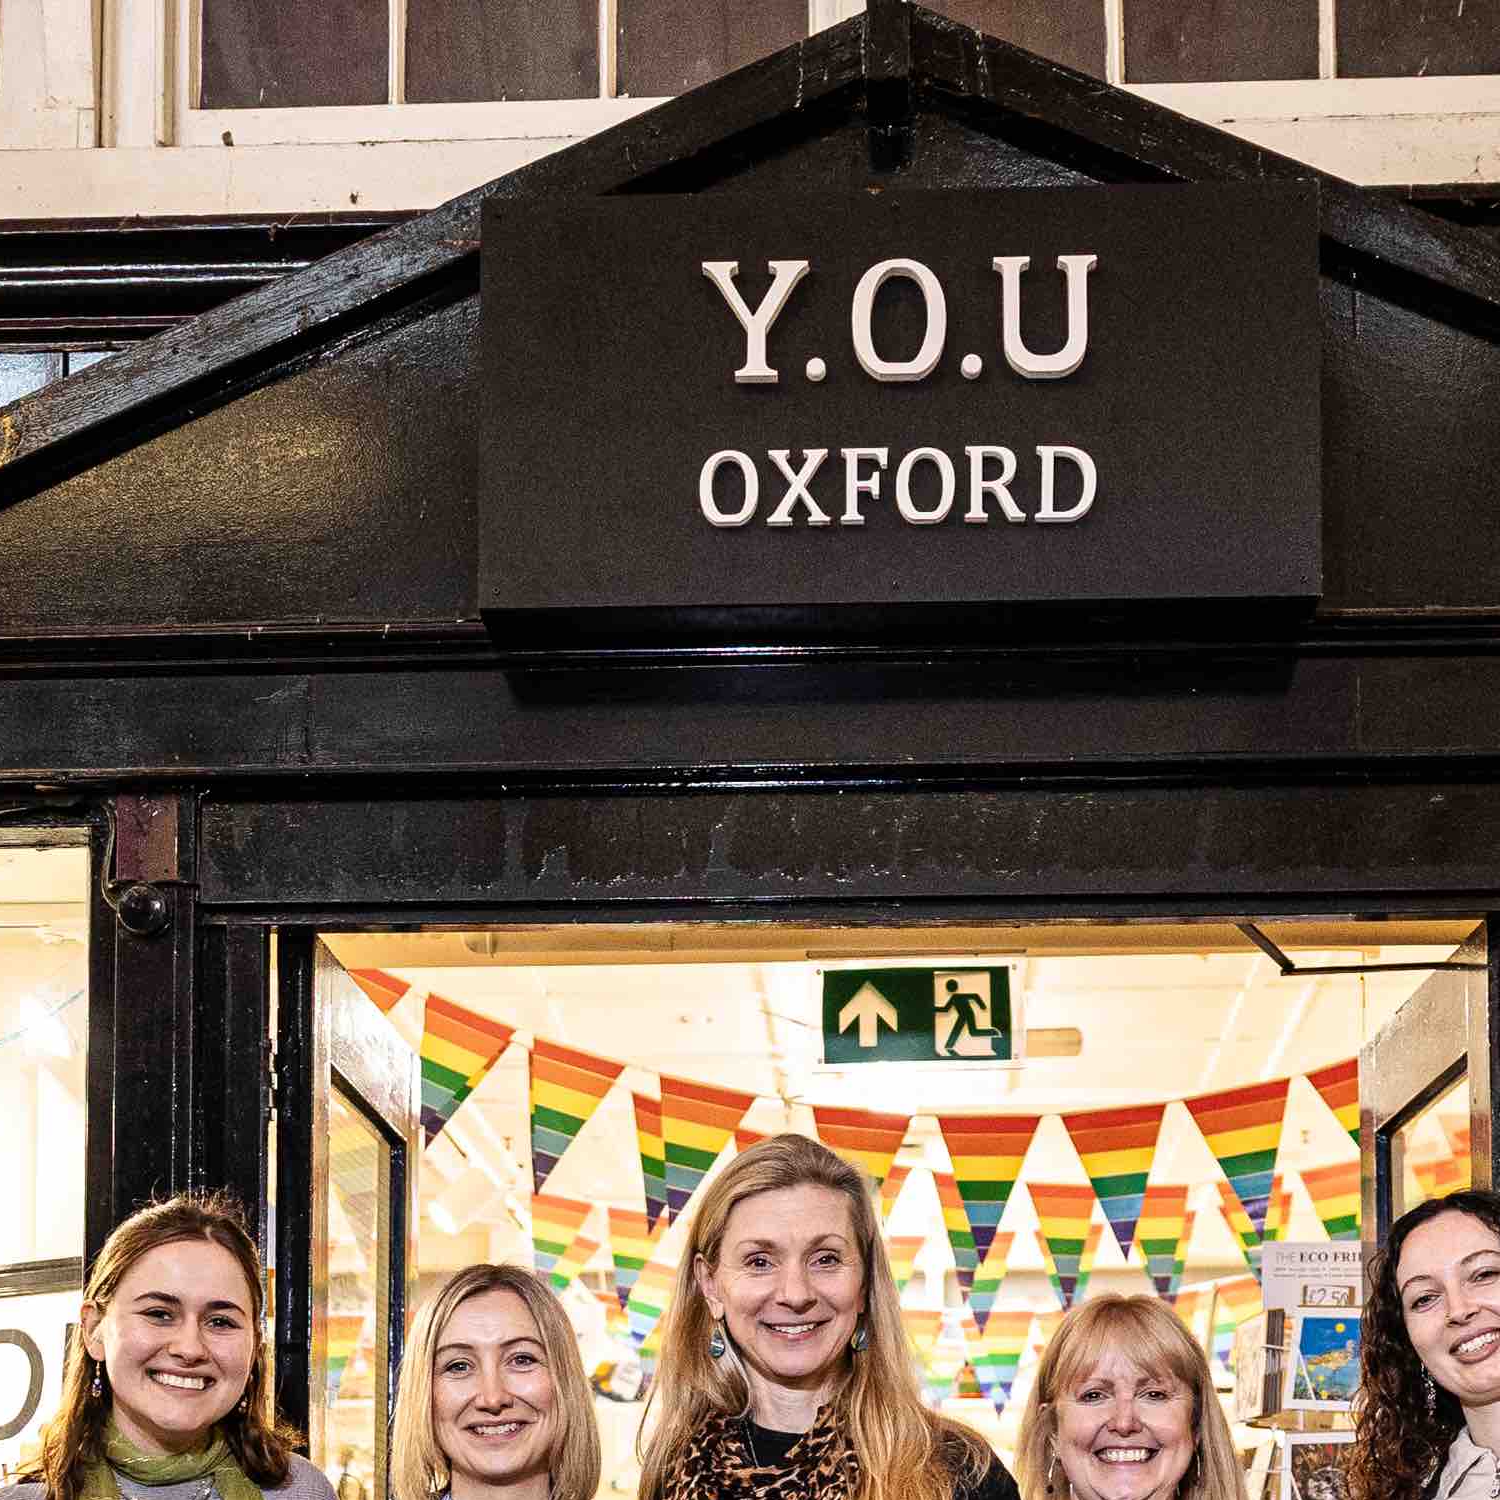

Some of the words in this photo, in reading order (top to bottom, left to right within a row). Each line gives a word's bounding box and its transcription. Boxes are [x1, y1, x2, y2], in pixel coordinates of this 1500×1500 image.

[702, 254, 1097, 383] Y.O.U
[699, 445, 1097, 528] OXFORD
[1300, 1251, 1328, 1262] ECO
